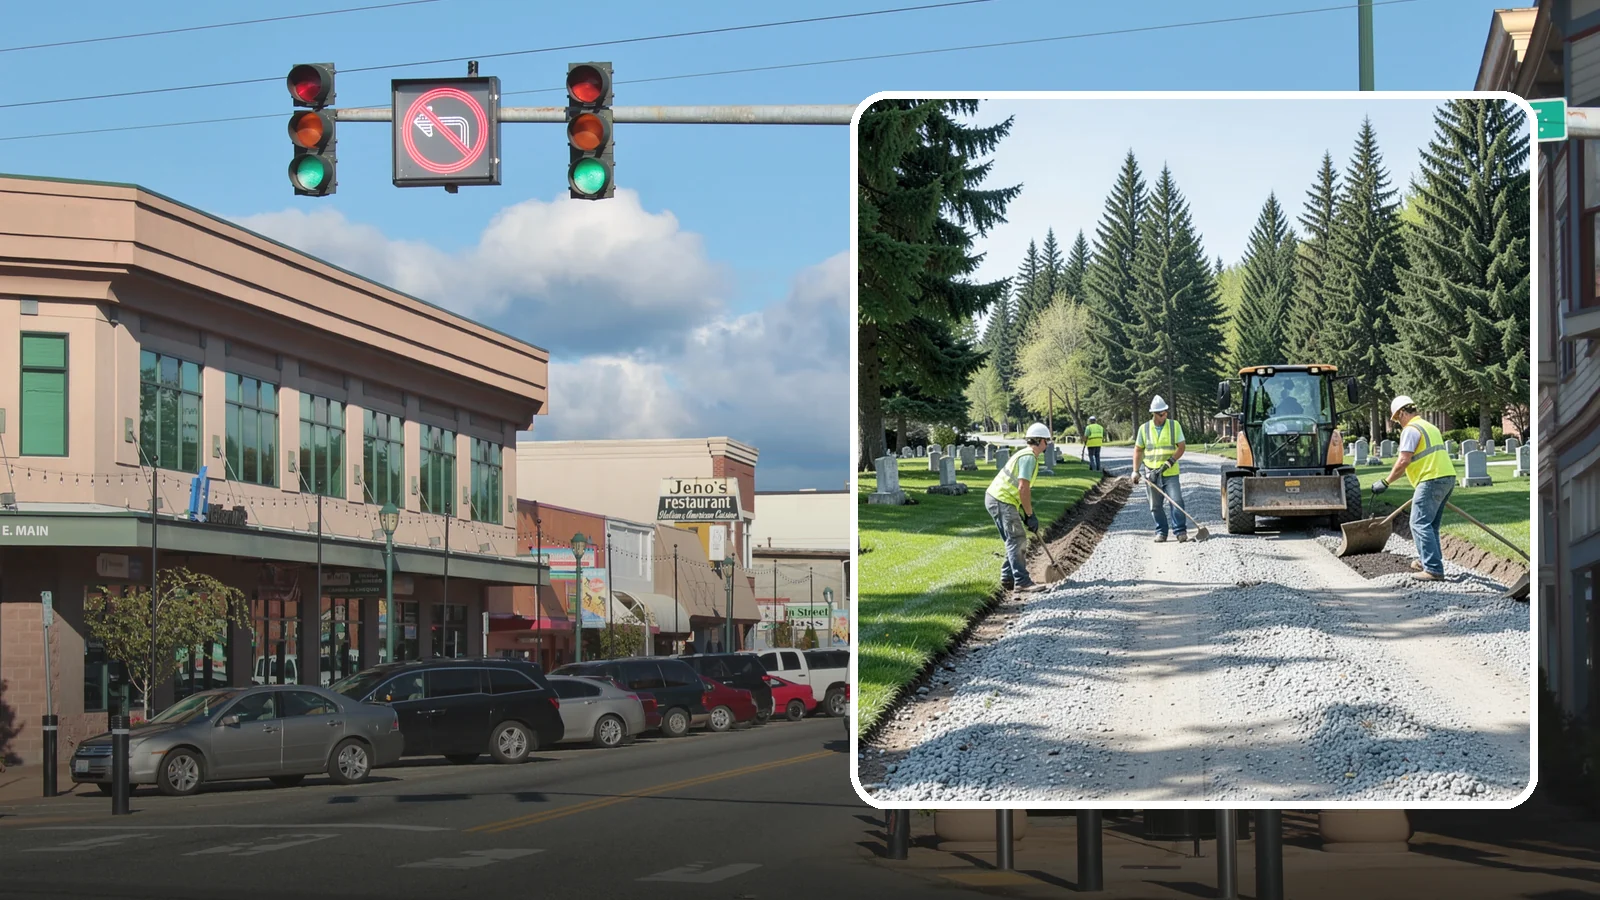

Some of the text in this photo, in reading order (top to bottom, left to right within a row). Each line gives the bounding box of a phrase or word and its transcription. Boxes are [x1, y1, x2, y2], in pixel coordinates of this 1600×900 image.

[670, 480, 728, 494] Jeno's
[665, 496, 731, 509] restaurant
[686, 510, 715, 519] American
[715, 510, 737, 519] Cuisine
[2, 525, 49, 536] E. MAIN
[798, 607, 828, 617] Street
[791, 619, 824, 627] lass
